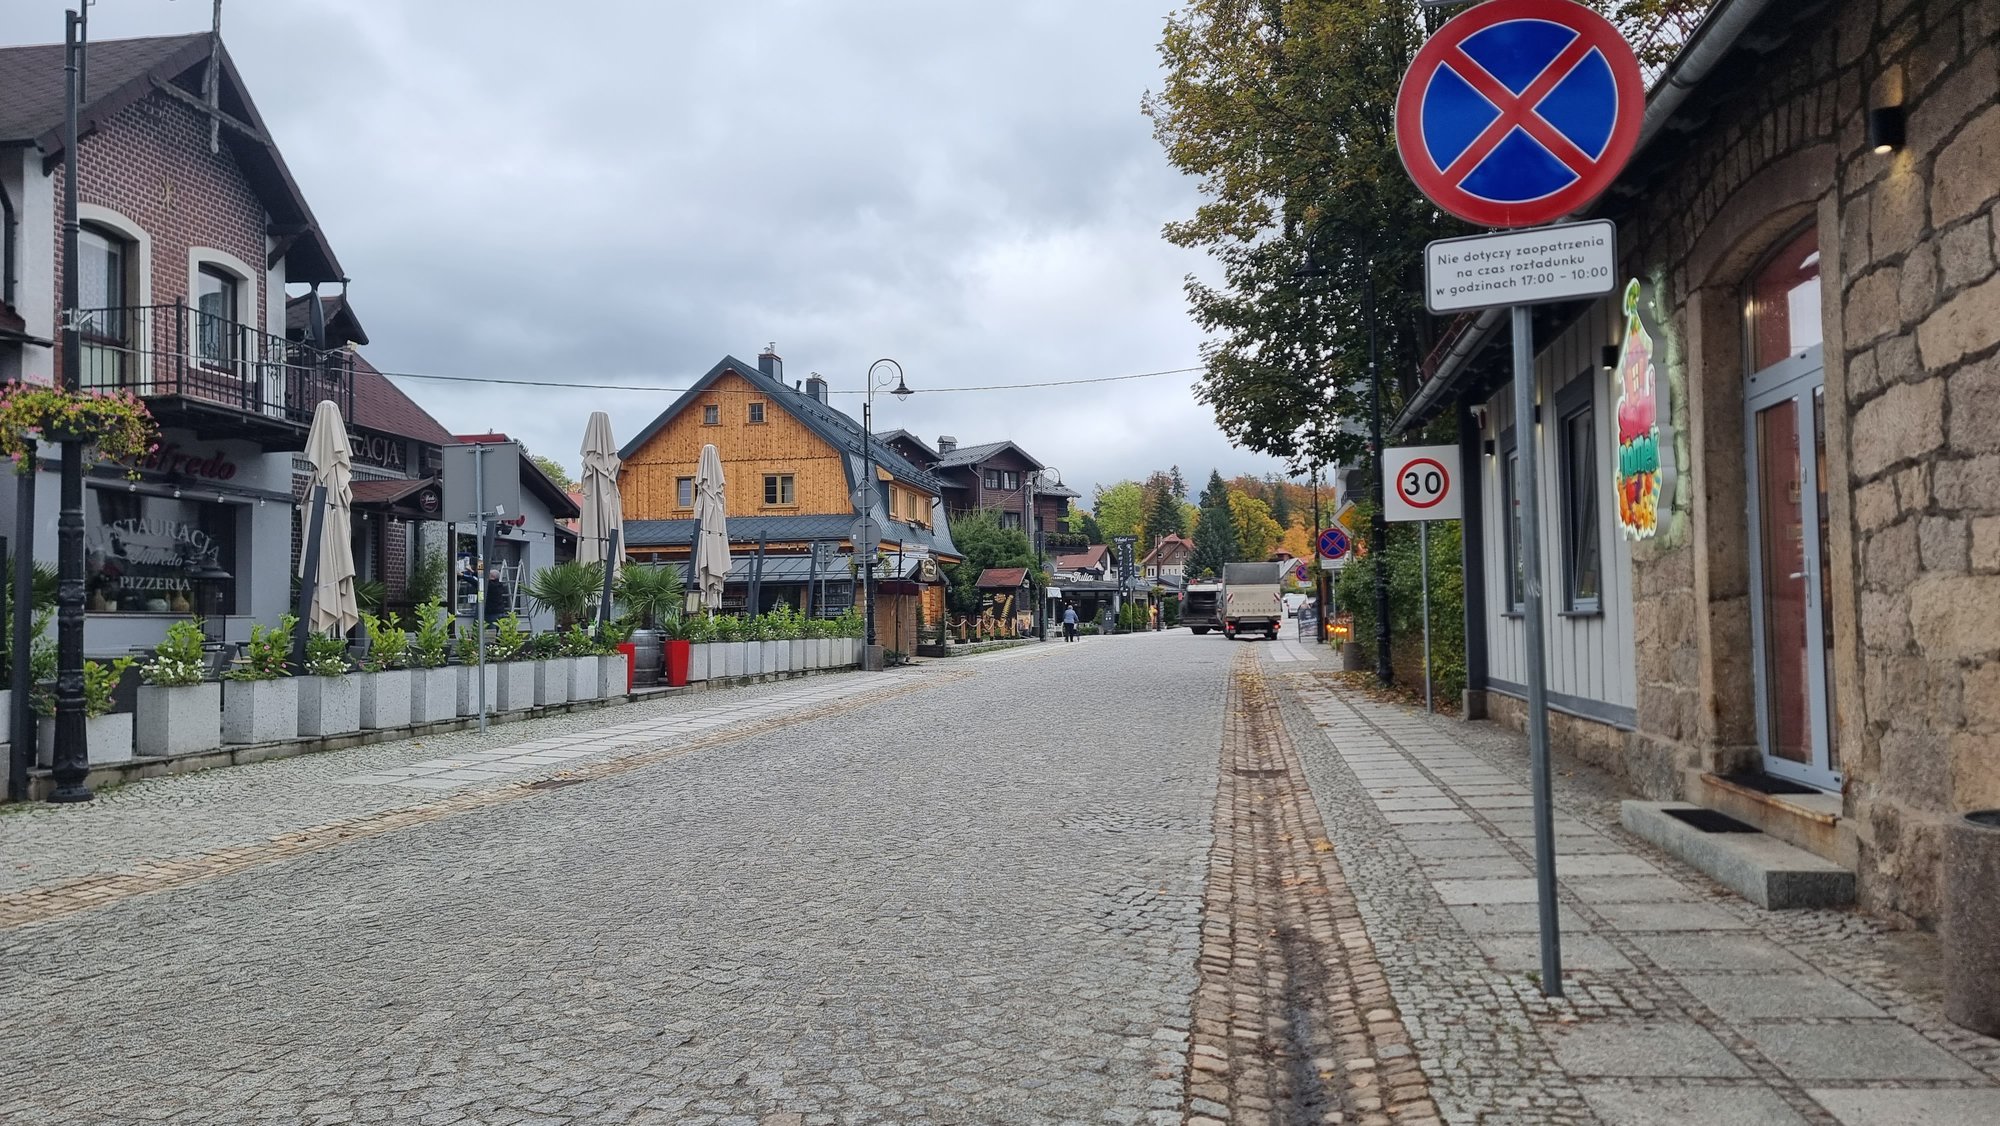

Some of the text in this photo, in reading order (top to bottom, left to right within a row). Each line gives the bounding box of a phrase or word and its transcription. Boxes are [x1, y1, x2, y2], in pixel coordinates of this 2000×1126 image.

[1438, 236, 1604, 265] Nie dotyczy zaopatrzenia
[1457, 254, 1585, 279] na czas rozładunku
[1436, 287, 1445, 296] w
[1450, 278, 1517, 297] godzinach
[1521, 272, 1555, 286] 17:00
[1571, 266, 1608, 280] 10:00
[1404, 471, 1442, 496] 30
[120, 575, 192, 591] PIZZERIA
[1070, 571, 1094, 583] Julia
